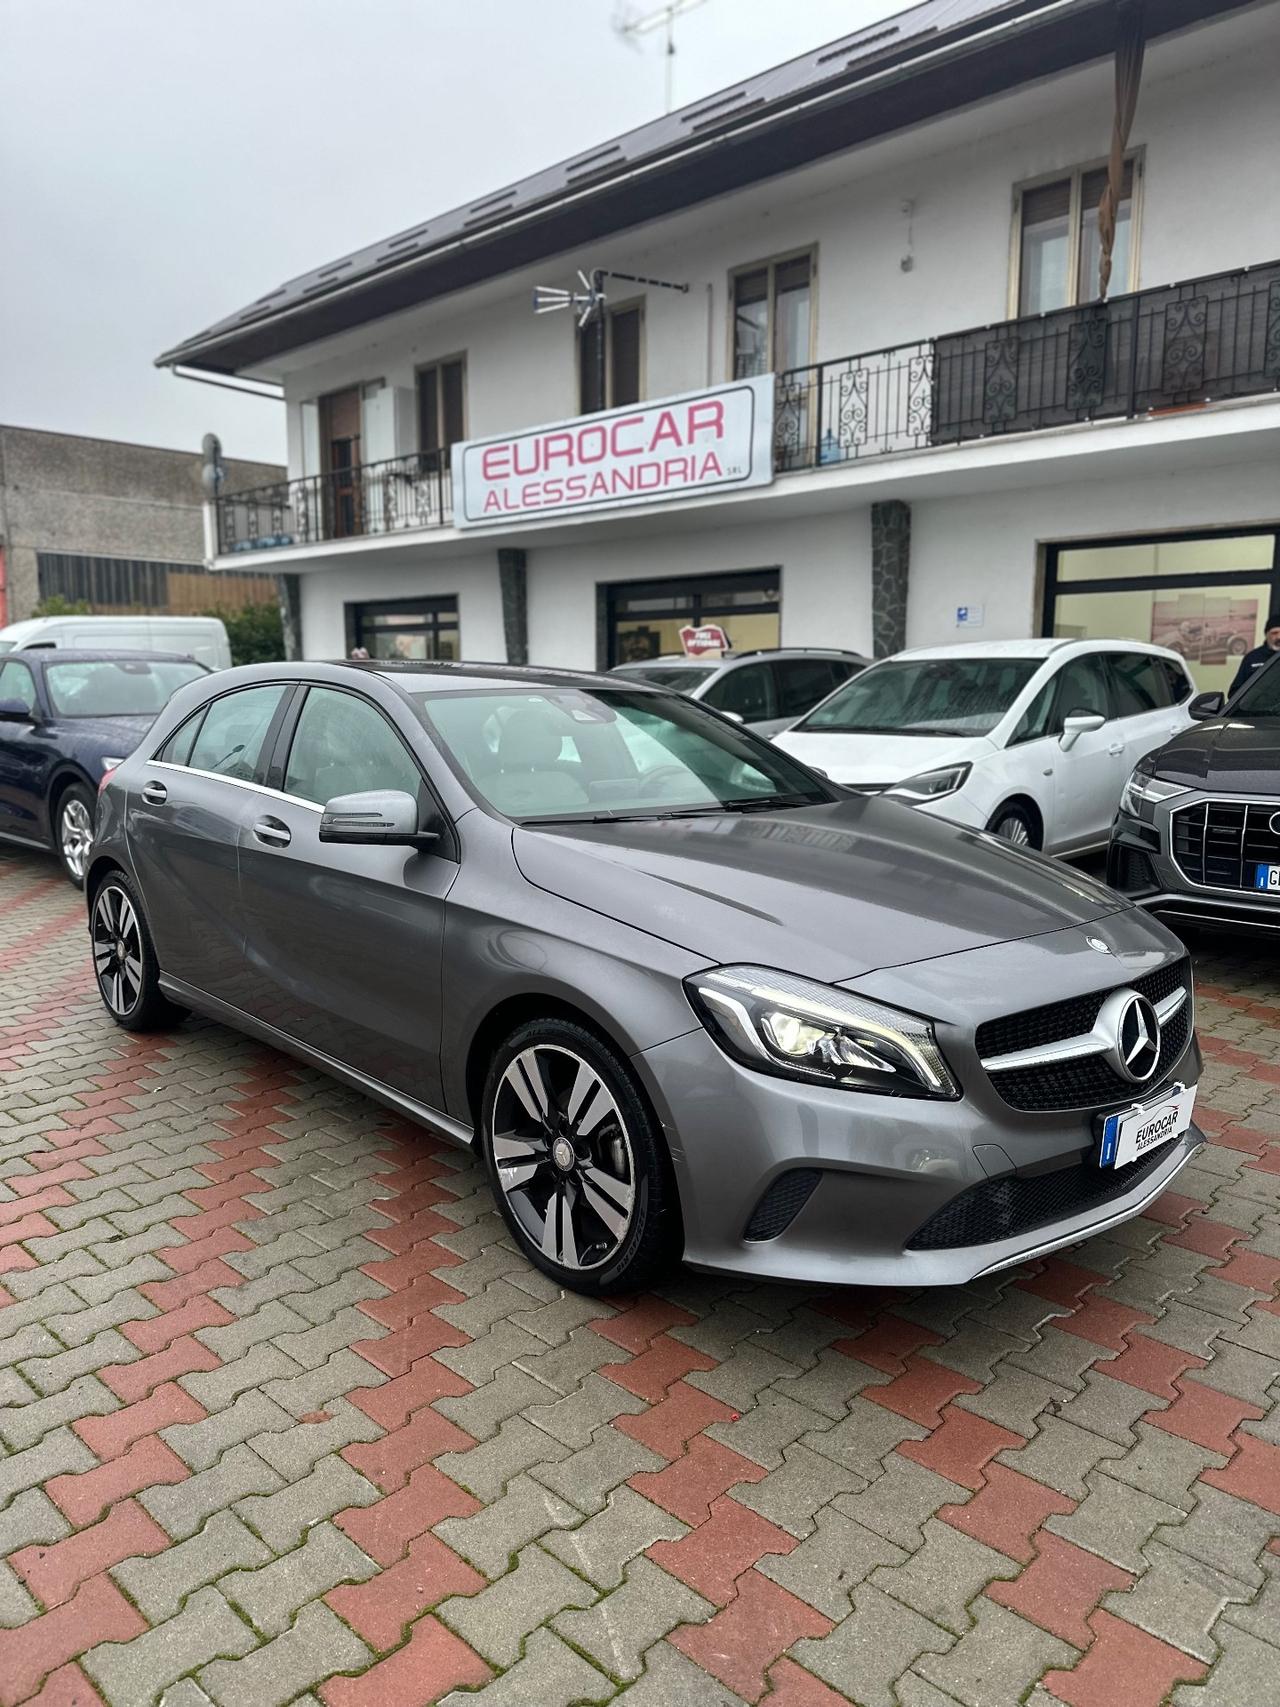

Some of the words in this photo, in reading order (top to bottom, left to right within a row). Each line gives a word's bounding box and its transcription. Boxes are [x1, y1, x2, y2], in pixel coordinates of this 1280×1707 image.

[482, 400, 724, 481] EUROCAR
[483, 451, 723, 513] ALESSANDRIA
[1269, 870, 1280, 886] G
[1136, 1111, 1179, 1144] EUROCAR
[1137, 1126, 1173, 1152] ALESSANDRIA
